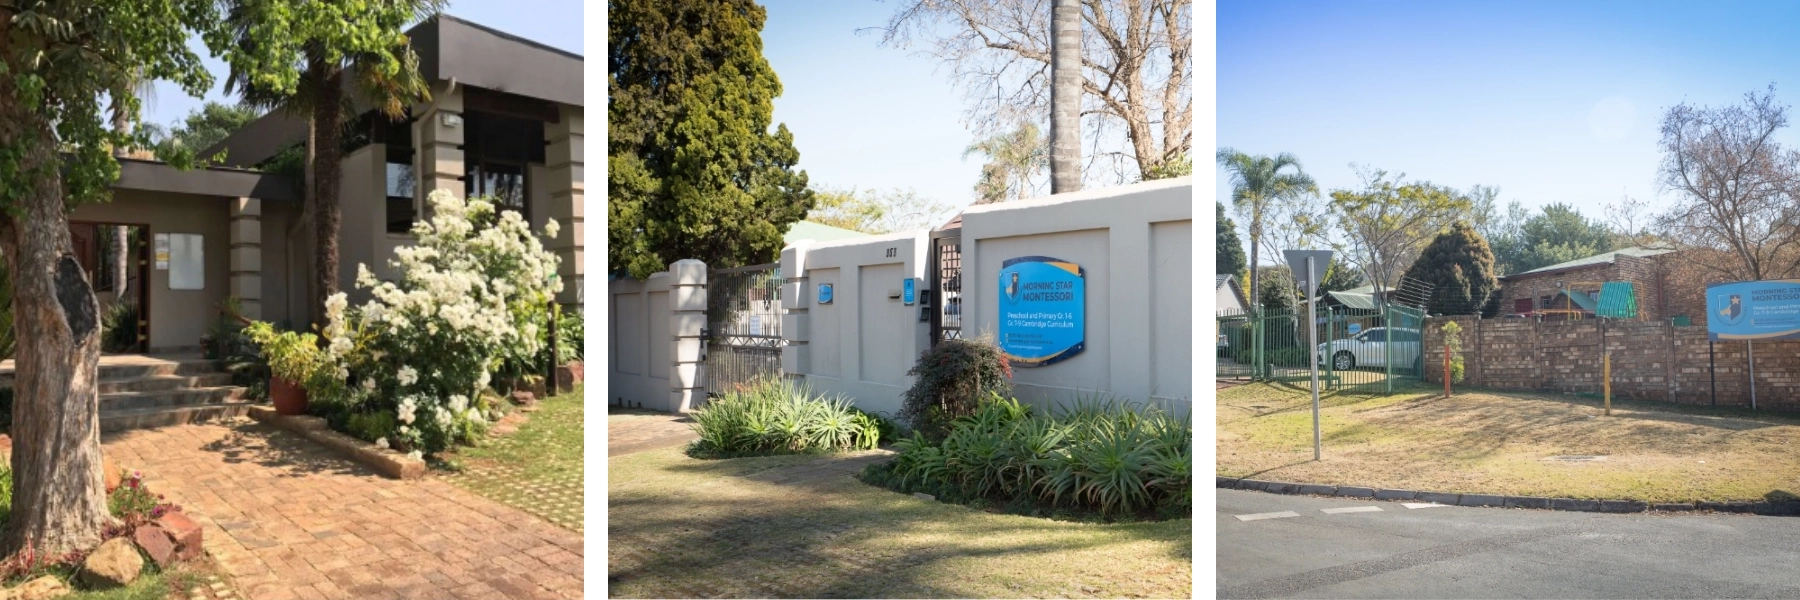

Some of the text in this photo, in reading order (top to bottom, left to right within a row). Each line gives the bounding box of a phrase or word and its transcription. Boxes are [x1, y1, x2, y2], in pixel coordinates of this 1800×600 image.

[1023, 281, 1073, 291] MORNING STAR
[1023, 292, 1074, 301] MONTESSORI
[1038, 312, 1057, 321] Primary
[1021, 320, 1047, 328] Cambridge
